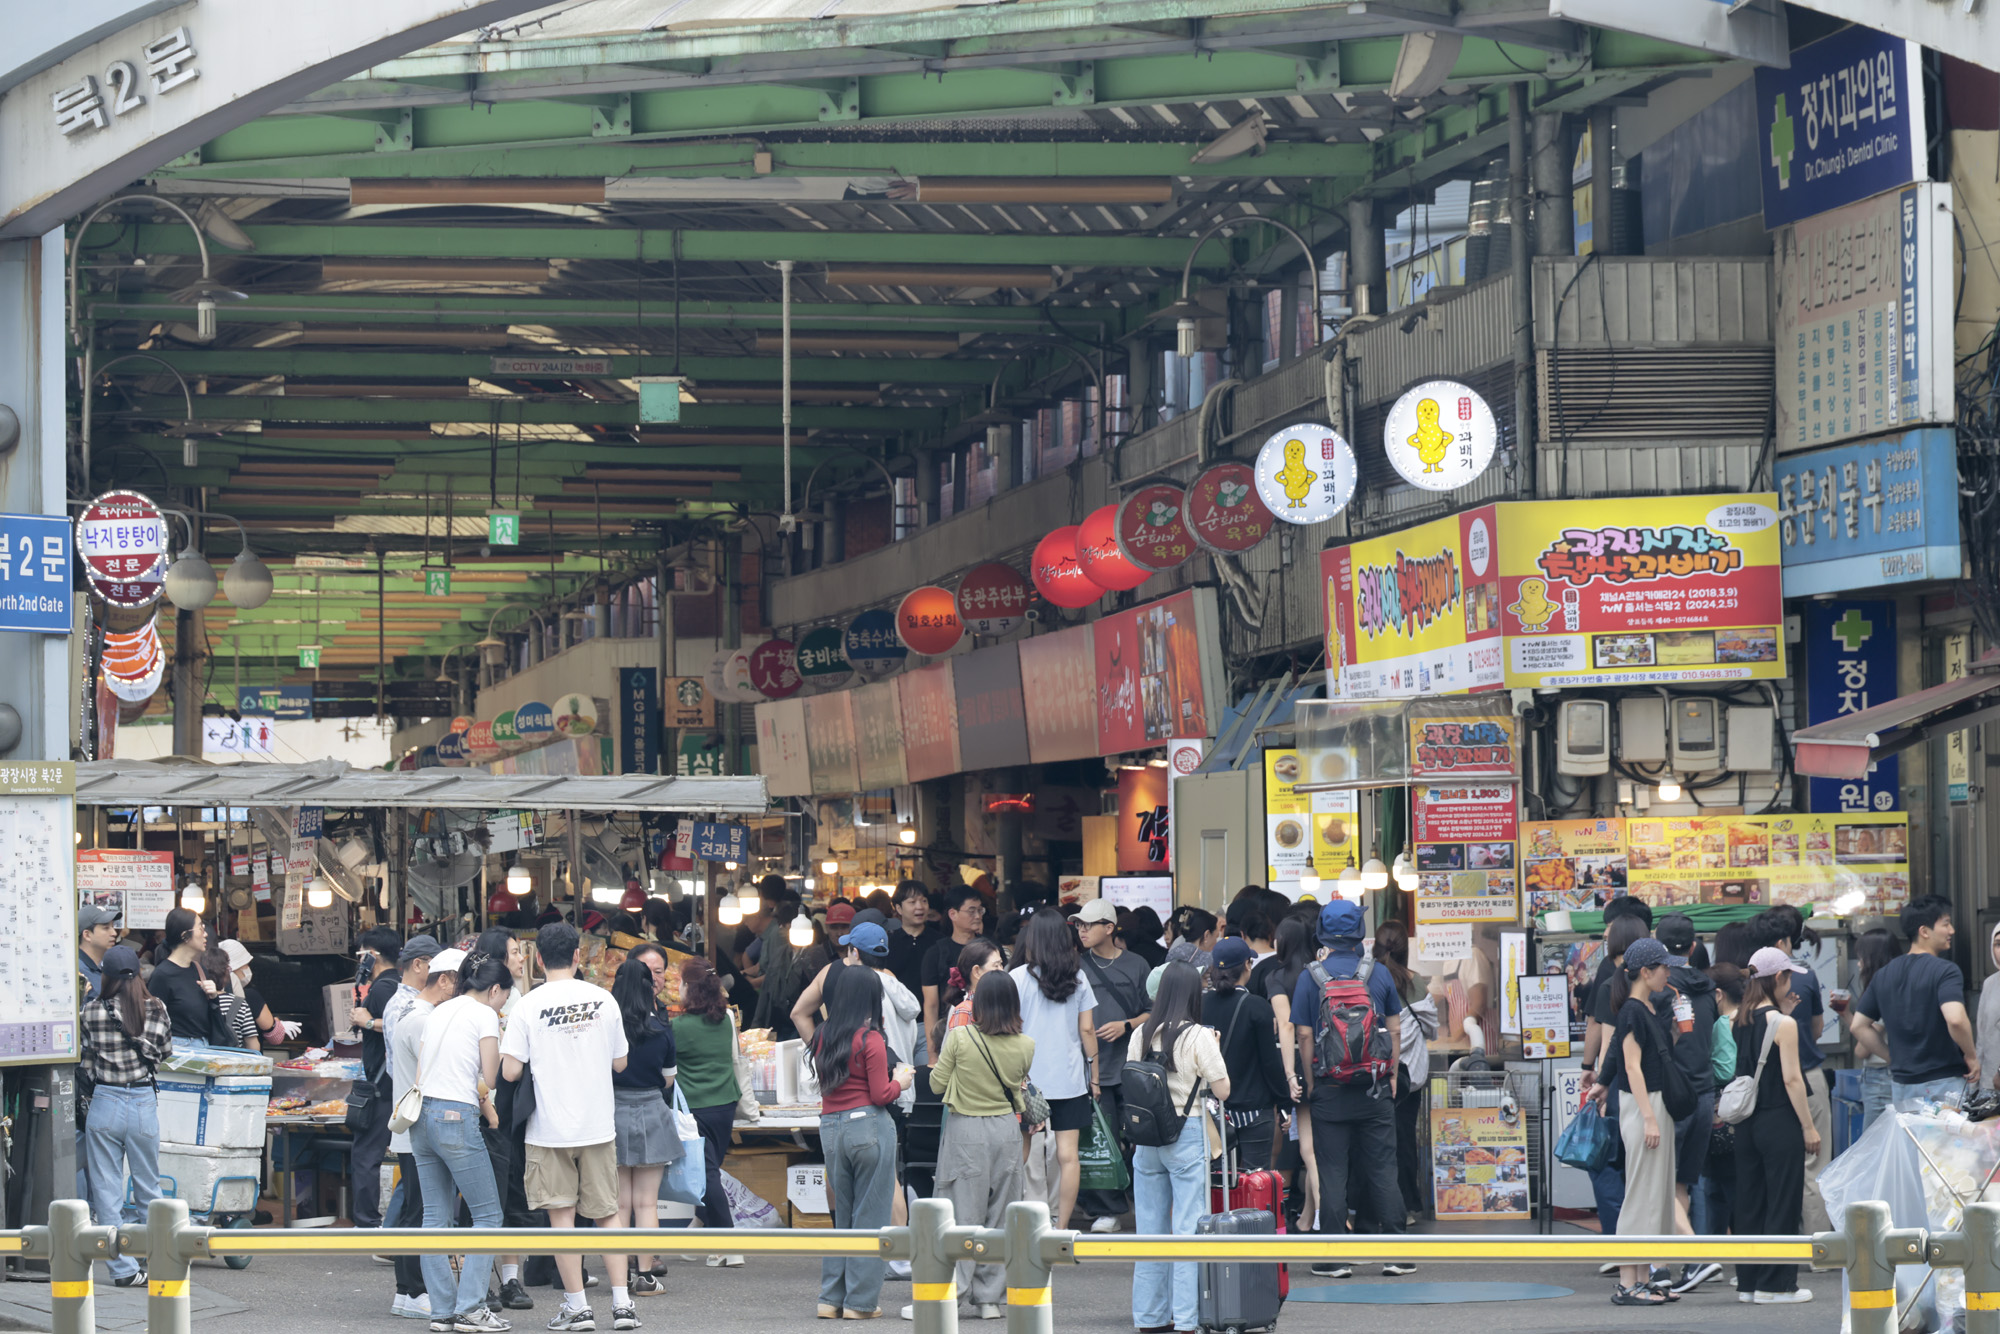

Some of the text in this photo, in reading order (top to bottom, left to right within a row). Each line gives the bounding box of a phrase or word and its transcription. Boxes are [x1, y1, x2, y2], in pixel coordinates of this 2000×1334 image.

[52, 26, 199, 136] 북2문
[1801, 50, 1896, 150] 정치과의원
[1847, 140, 1874, 166] Dental
[1875, 132, 1898, 157] Clinic
[1902, 198, 1917, 370] 동양금박
[512, 362, 540, 371] CCTV
[1458, 431, 1473, 470] 꽈배기
[1322, 470, 1335, 504] 꽈배기
[1779, 458, 1884, 546] 동문직물부
[1725, 507, 1756, 516] 광장시장
[1717, 517, 1766, 528] 최고의 꽈배기
[86, 525, 159, 549] 낙지탕탕이
[1226, 524, 1262, 540] 육회
[1564, 528, 1710, 555] 광장시장
[1153, 544, 1187, 559] 육회
[105, 558, 141, 573] 전문
[110, 584, 142, 597] 전문
[19, 595, 38, 612] 2nd
[40, 596, 63, 612] Gate
[1601, 603, 1622, 613] tvN
[906, 613, 957, 628] 일호상회
[978, 619, 1011, 631] 입구
[863, 659, 892, 670] 입구
[761, 670, 798, 690] 人参
[1550, 669, 1742, 685] 종로5가 9번출구 광장시장 북2문앞 010.9498.3115
[1427, 724, 1500, 744] 광장시장
[1418, 746, 1510, 768] 찹쌀꽈배기
[0, 768, 63, 784] 광장시장 북2문
[1876, 796, 1891, 805] 3F
[300, 810, 323, 834] 광장호떡
[678, 833, 690, 843] 27
[1575, 827, 1592, 837] tvN
[321, 916, 339, 926] 종이컵
[1442, 909, 1493, 917] 010.9498.3115
[288, 936, 326, 951] CUPS
[540, 1001, 604, 1019] NASTY
[548, 1011, 596, 1027] KICK
